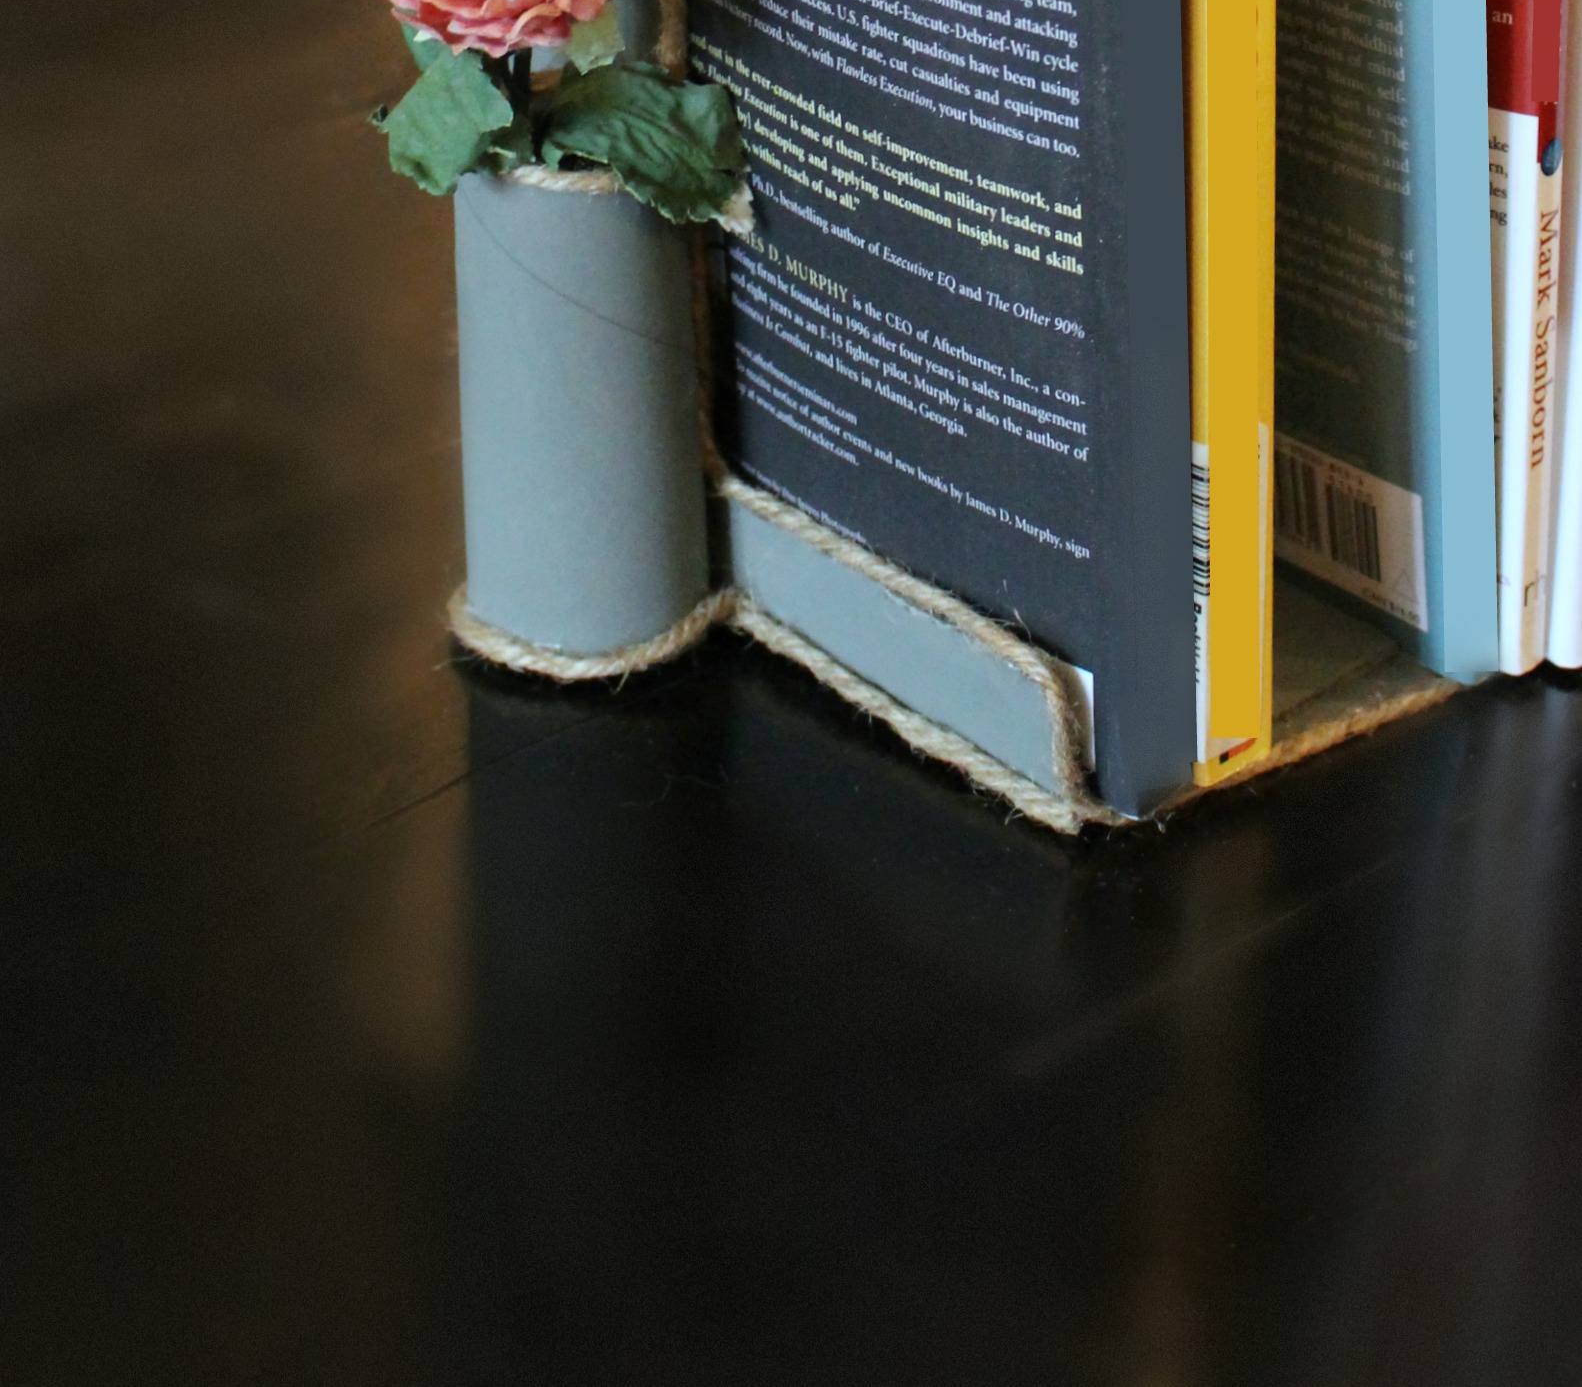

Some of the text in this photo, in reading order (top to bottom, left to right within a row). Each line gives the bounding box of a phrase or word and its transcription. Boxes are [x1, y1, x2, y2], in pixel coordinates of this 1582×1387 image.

[837, 4, 1080, 106] U.S. fighter squadrons have been using
[985, 9, 1011, 26] and
[1014, 17, 1078, 49] attacking
[1492, 10, 1513, 25] an
[861, 45, 1079, 129] rate, cut casualties and equipment
[1043, 54, 1079, 73] cycle
[879, 75, 1080, 158] Execution, your business can too.
[817, 104, 1082, 220] field on self-improvement, teamwork, and
[871, 155, 1083, 248] Exceptional military leaders and
[883, 190, 1084, 275] uncommon insights and skills
[786, 255, 1086, 407] MURPHY is the CEO of Afterburner, Inc., a con-
[883, 246, 1085, 339] Executive EQ and The Other 90%
[1531, 209, 1558, 469] Mark Sanborn
[874, 381, 967, 437] Atlanta, Georgia.
[899, 343, 1087, 435] four years in sales management
[914, 374, 1090, 462] Murphy is also the author of
[965, 492, 1090, 559] James D. Murphy, sign
